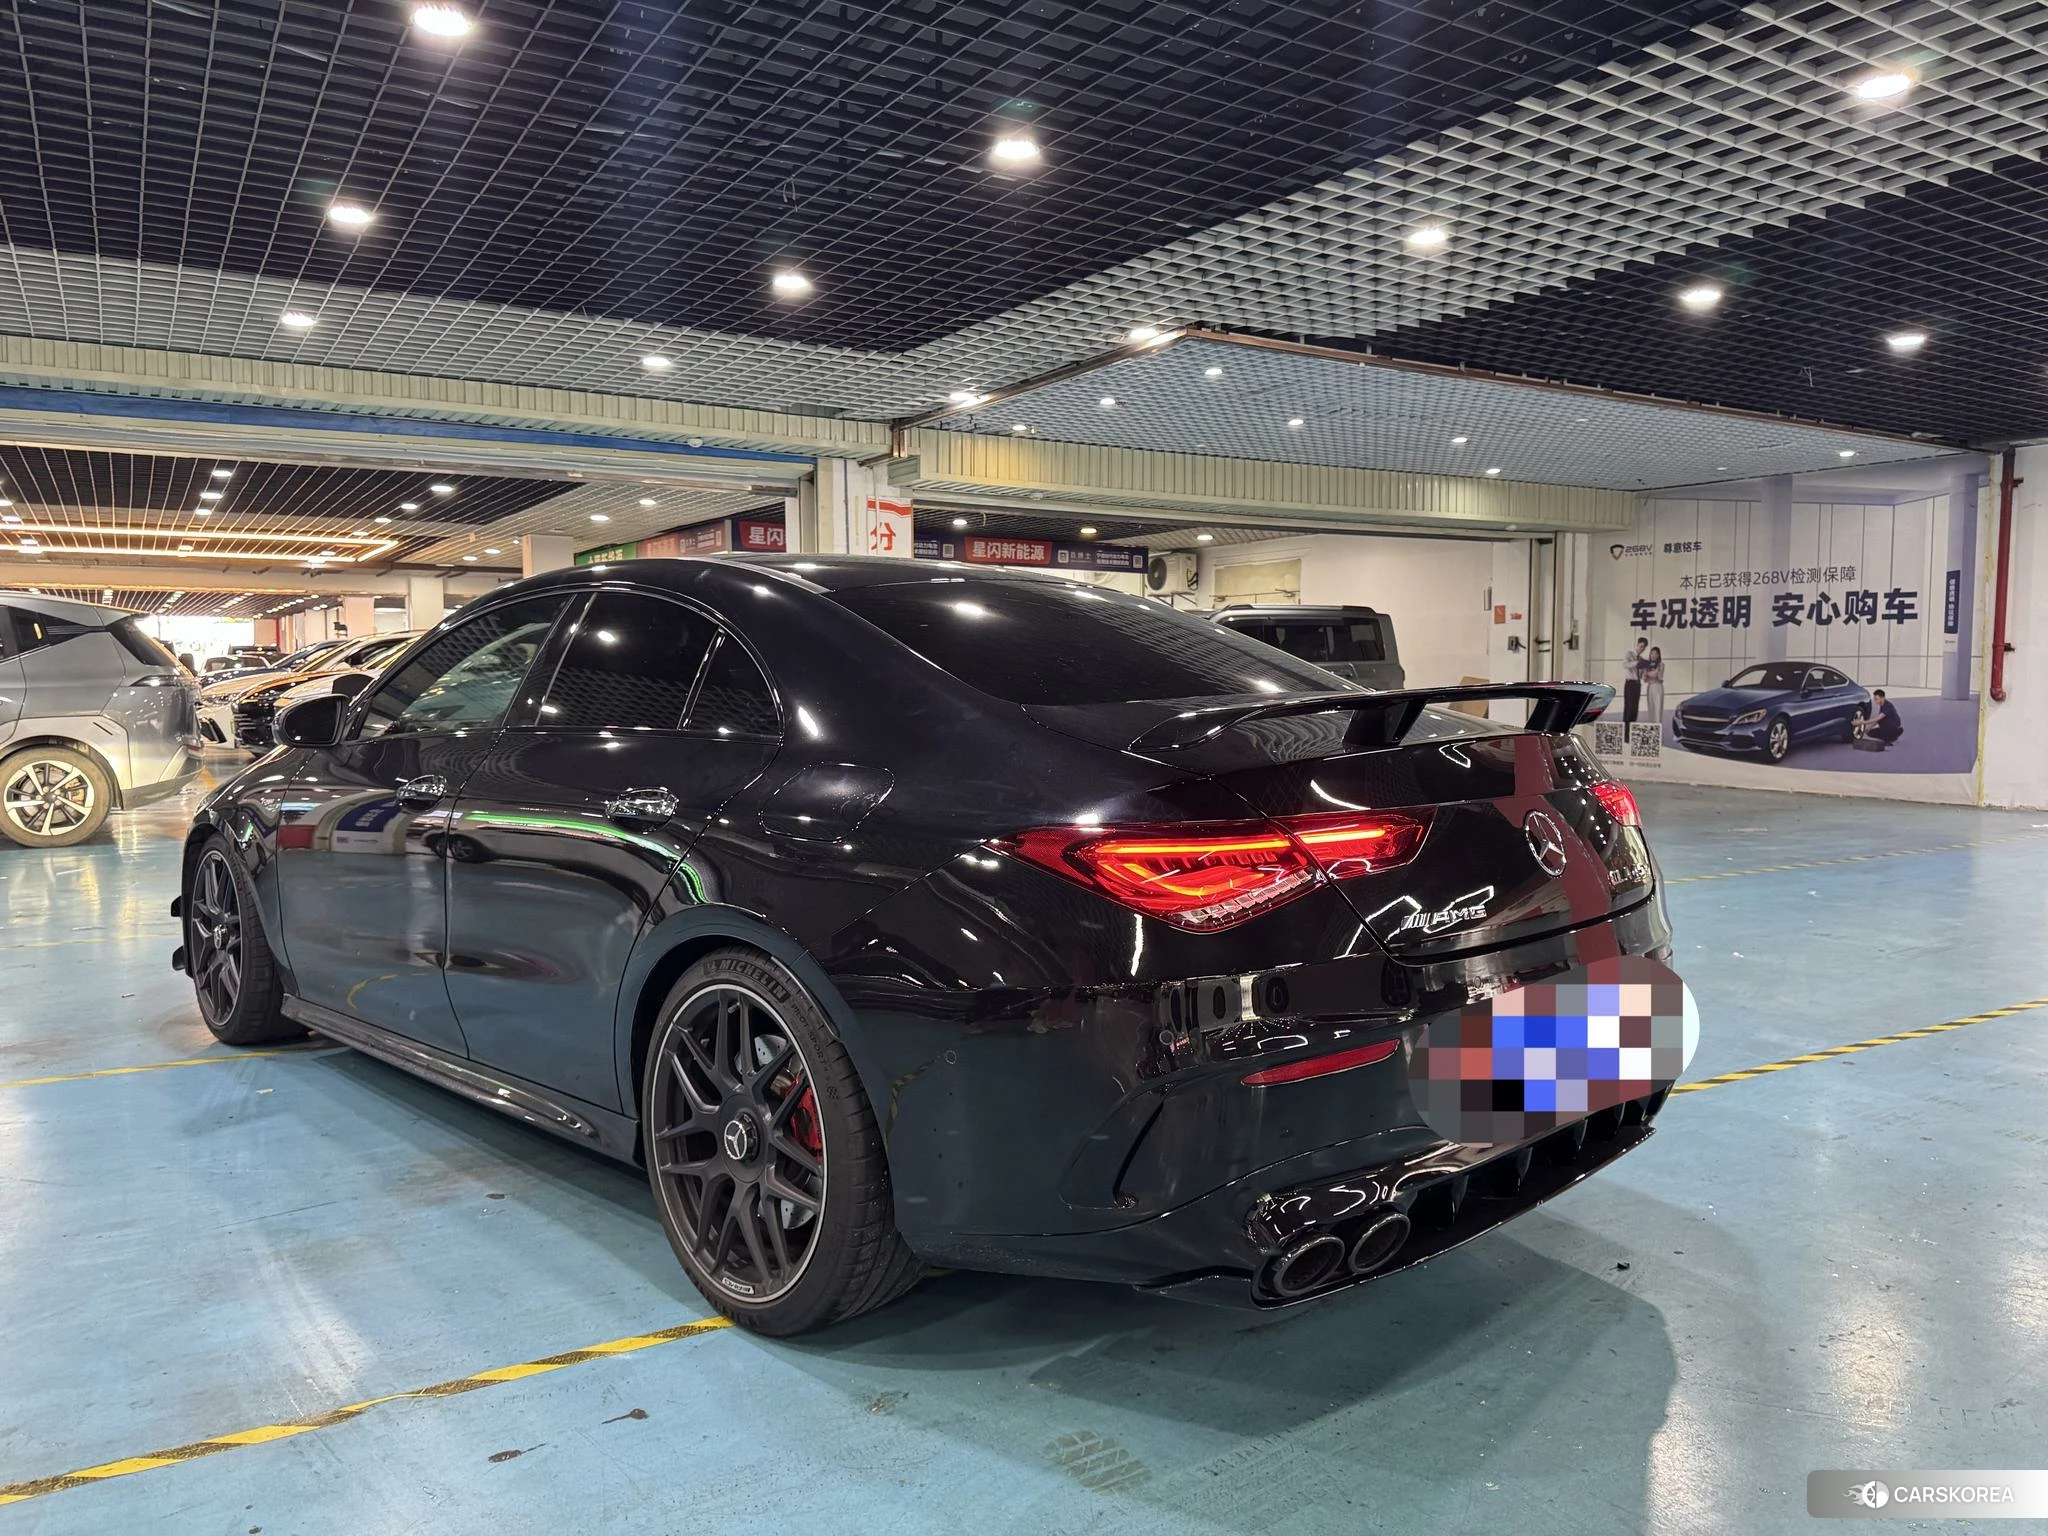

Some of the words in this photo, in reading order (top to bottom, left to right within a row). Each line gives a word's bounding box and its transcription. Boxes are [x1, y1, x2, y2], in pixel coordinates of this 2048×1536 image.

[749, 526, 784, 546] 星闪
[870, 522, 896, 551] 分
[972, 541, 1045, 560] 星闪新能源
[1680, 565, 1856, 590] 本店已获得268V检测保障
[1630, 595, 1751, 630] 车况透明
[1772, 588, 1918, 627] 安心购车
[1431, 905, 1487, 925] AMG
[720, 959, 787, 999] MICHELIN
